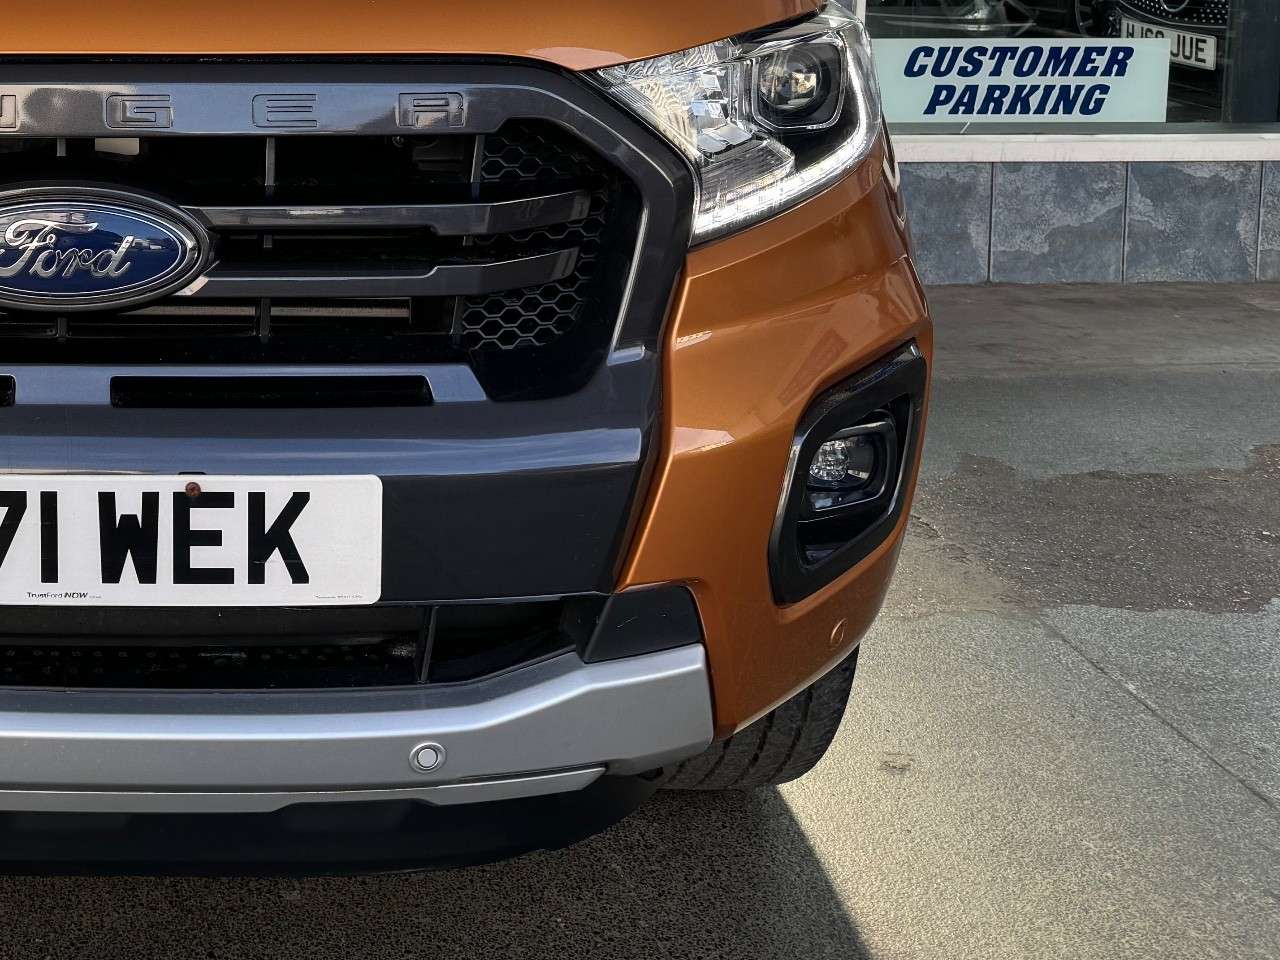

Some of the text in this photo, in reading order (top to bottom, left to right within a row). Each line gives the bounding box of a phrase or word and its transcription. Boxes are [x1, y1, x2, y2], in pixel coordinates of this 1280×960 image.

[904, 46, 1134, 77] CUSTOMER
[1170, 34, 1207, 63] JUE
[923, 84, 1110, 115] PARKING
[98, 491, 311, 585] WEK
